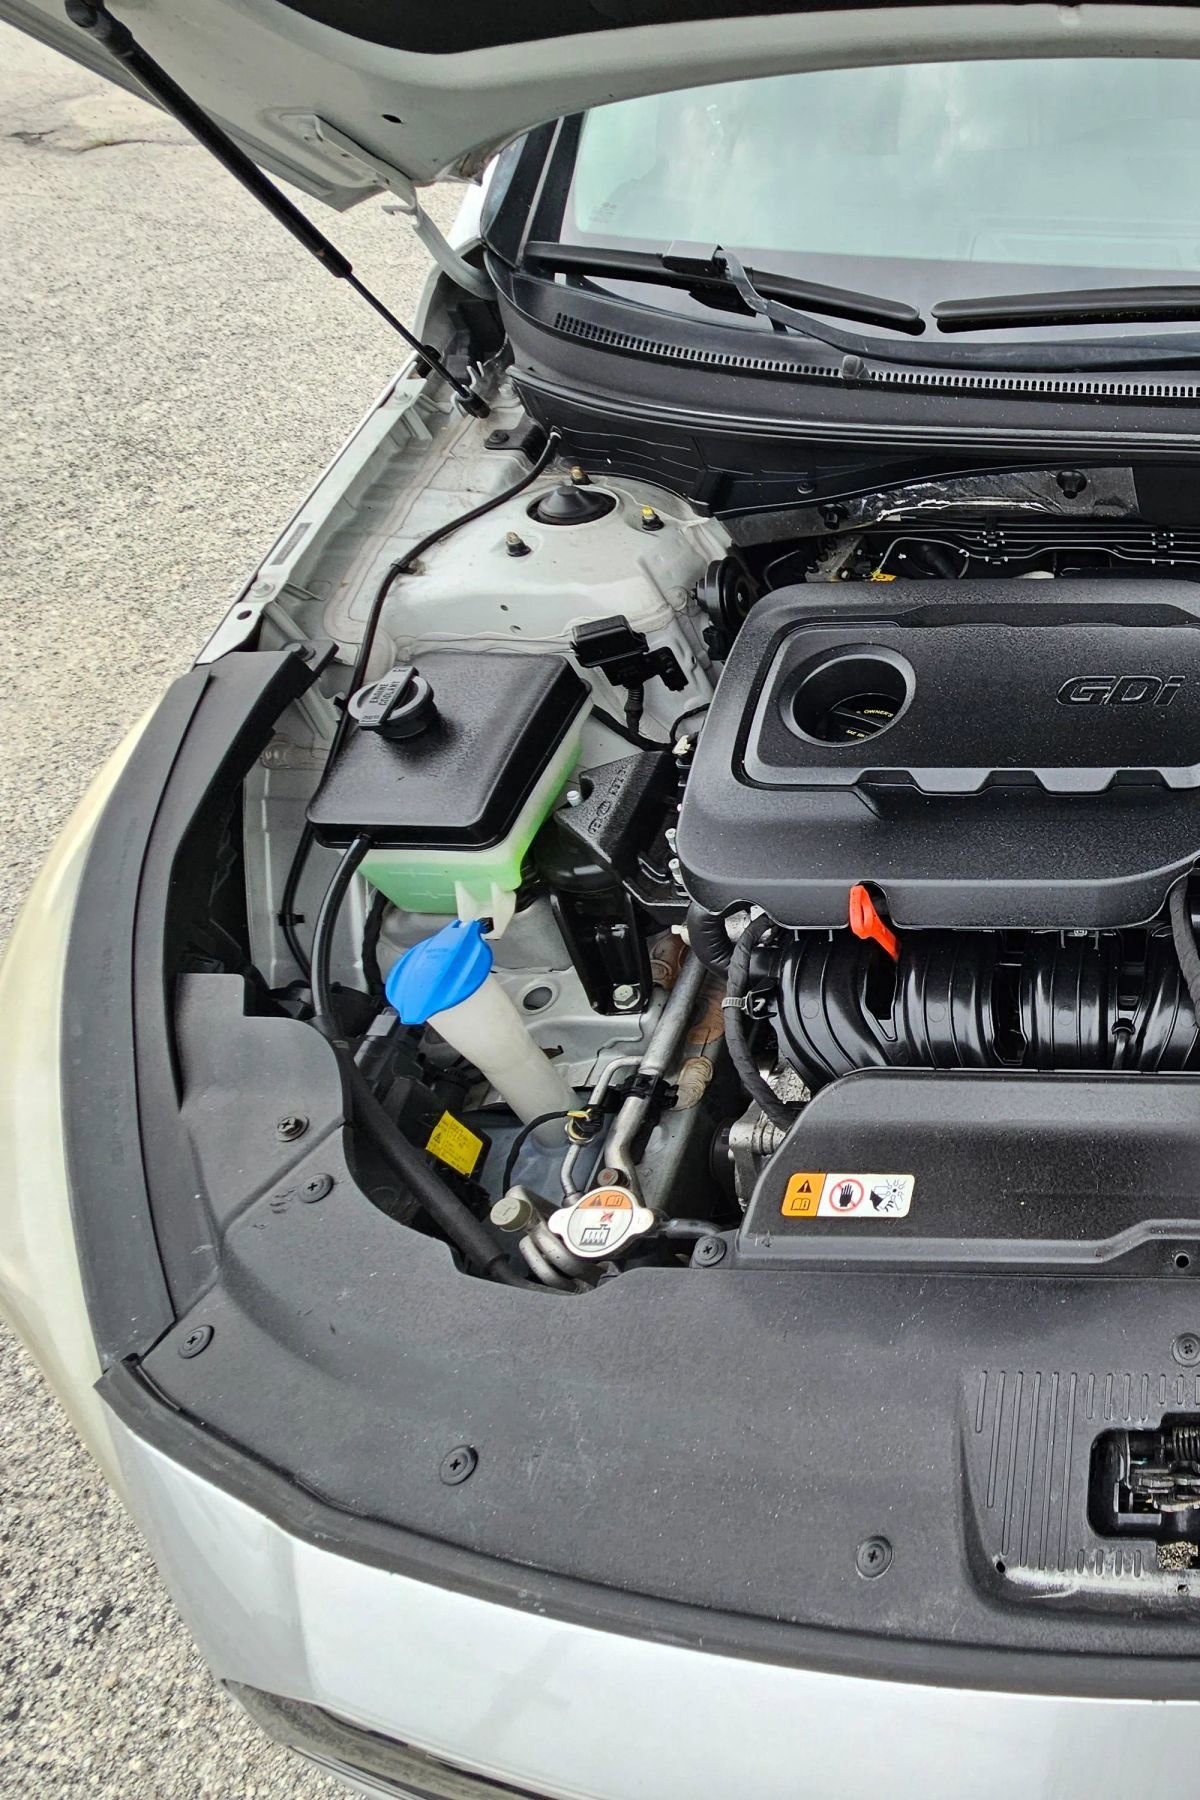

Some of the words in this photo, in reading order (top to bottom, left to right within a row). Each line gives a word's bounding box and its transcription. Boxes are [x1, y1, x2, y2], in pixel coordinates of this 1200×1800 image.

[369, 683, 388, 704] ENGINE
[378, 681, 401, 706] COOLANT
[1056, 675, 1185, 706] GDi
